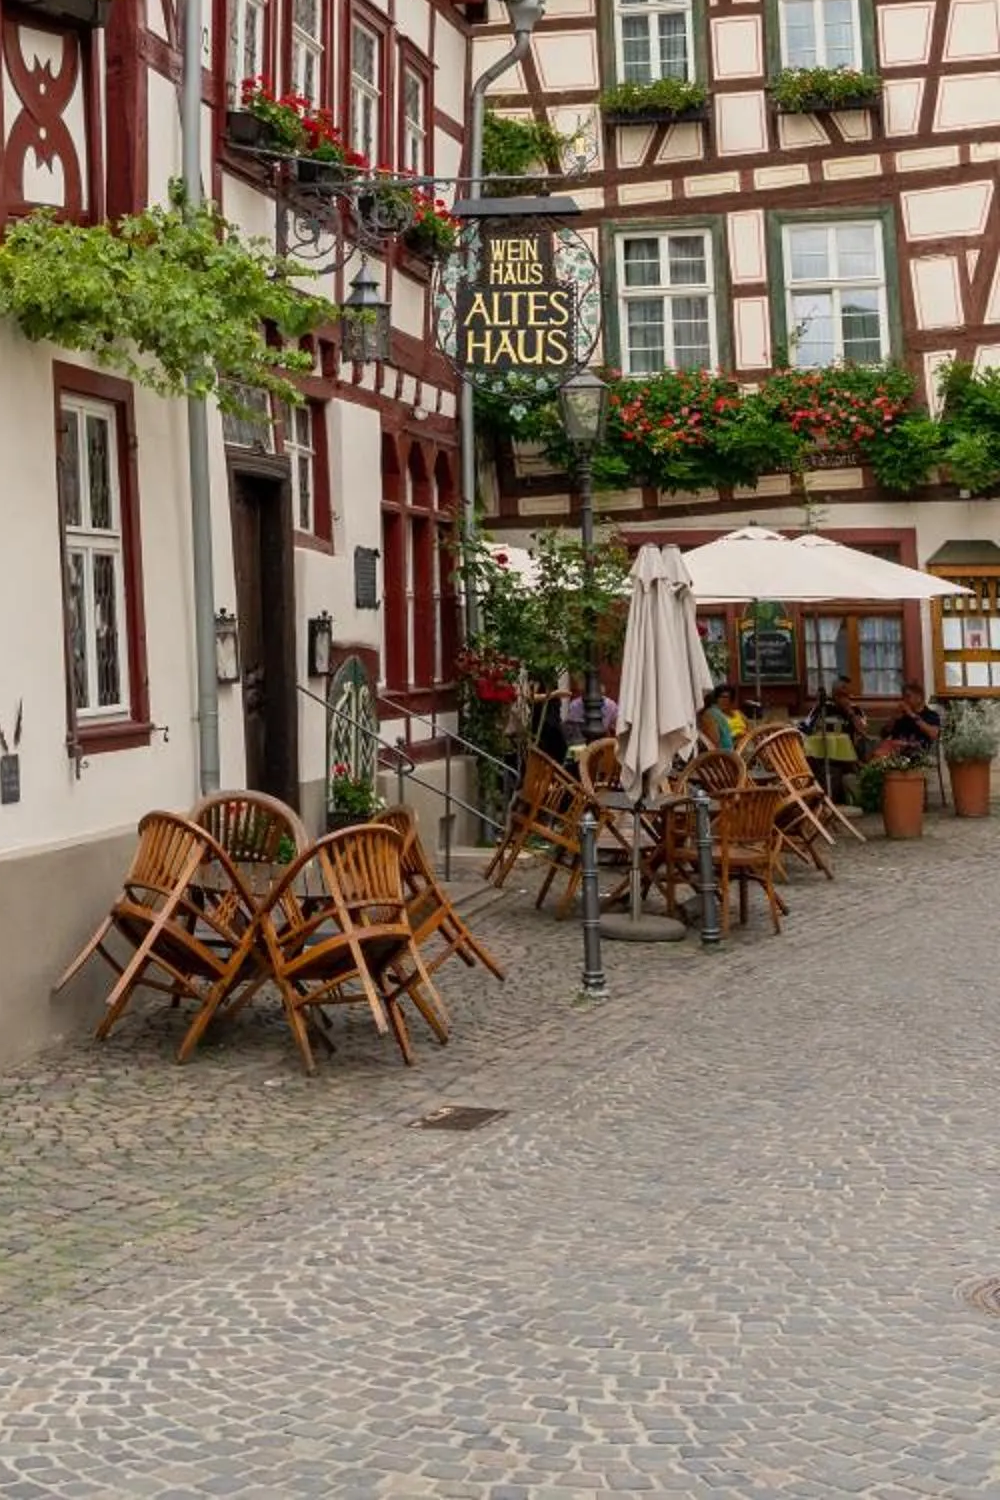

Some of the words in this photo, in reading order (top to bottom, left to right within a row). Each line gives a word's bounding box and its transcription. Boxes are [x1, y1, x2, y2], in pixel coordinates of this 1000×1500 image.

[490, 239, 538, 261] WEIN
[490, 263, 543, 285] HAUS
[463, 290, 570, 327] ALTES
[466, 329, 569, 365] HAUS
